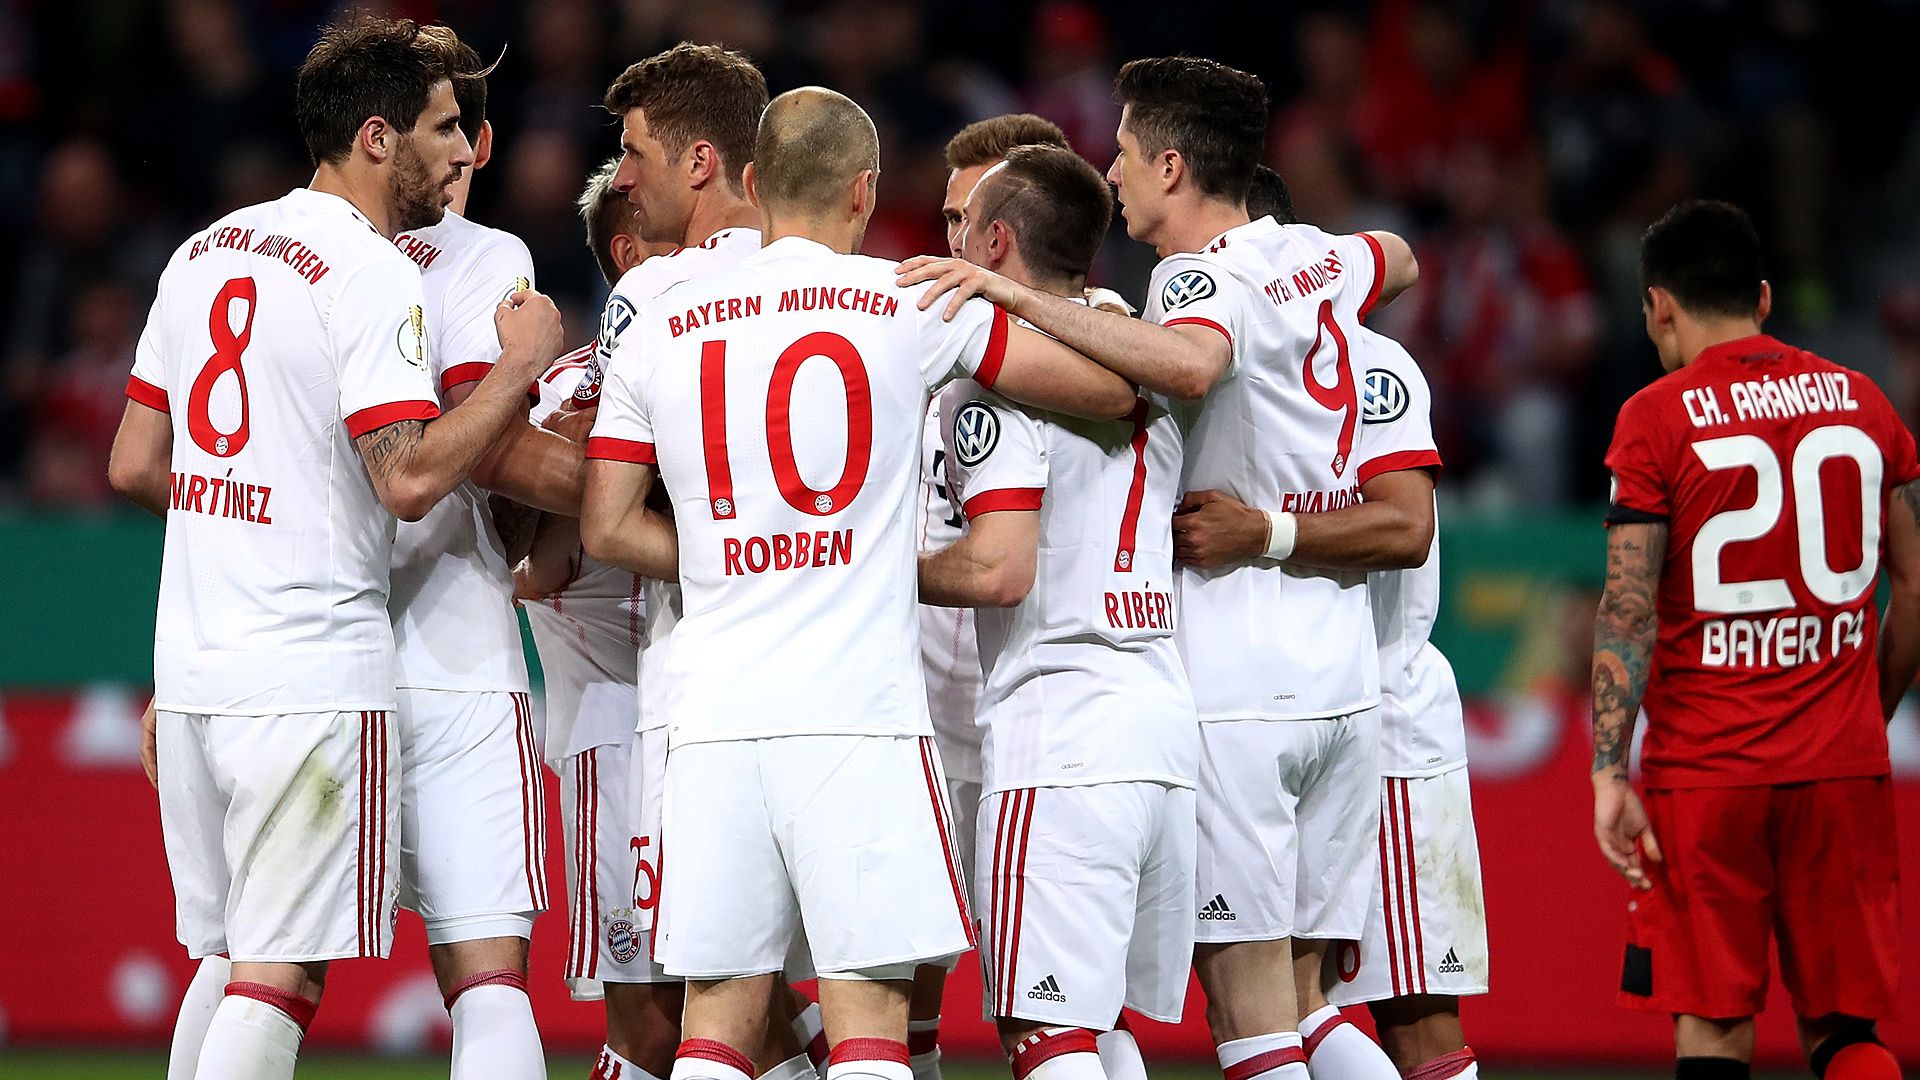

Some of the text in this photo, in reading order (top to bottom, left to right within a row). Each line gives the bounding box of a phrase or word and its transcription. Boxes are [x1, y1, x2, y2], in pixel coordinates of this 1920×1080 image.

[189, 227, 255, 261] BAYERN
[393, 234, 442, 269] CHEN
[669, 287, 898, 338] BAYERN MÜNCHEN
[188, 276, 256, 457] 8
[1302, 299, 1358, 479] 9
[700, 331, 872, 520] 10
[1681, 372, 1859, 428] CH. ARÁNGUIZ
[168, 468, 272, 525] MRTÍNEZ
[1691, 424, 1883, 613] 20
[724, 529, 852, 575] ROBBEN
[1104, 581, 1174, 630] RIBÉRY
[1701, 615, 1821, 668] BAYER
[1198, 910, 1237, 921] adidas
[1438, 963, 1464, 973] adidas
[1027, 990, 1067, 1003] adidas
